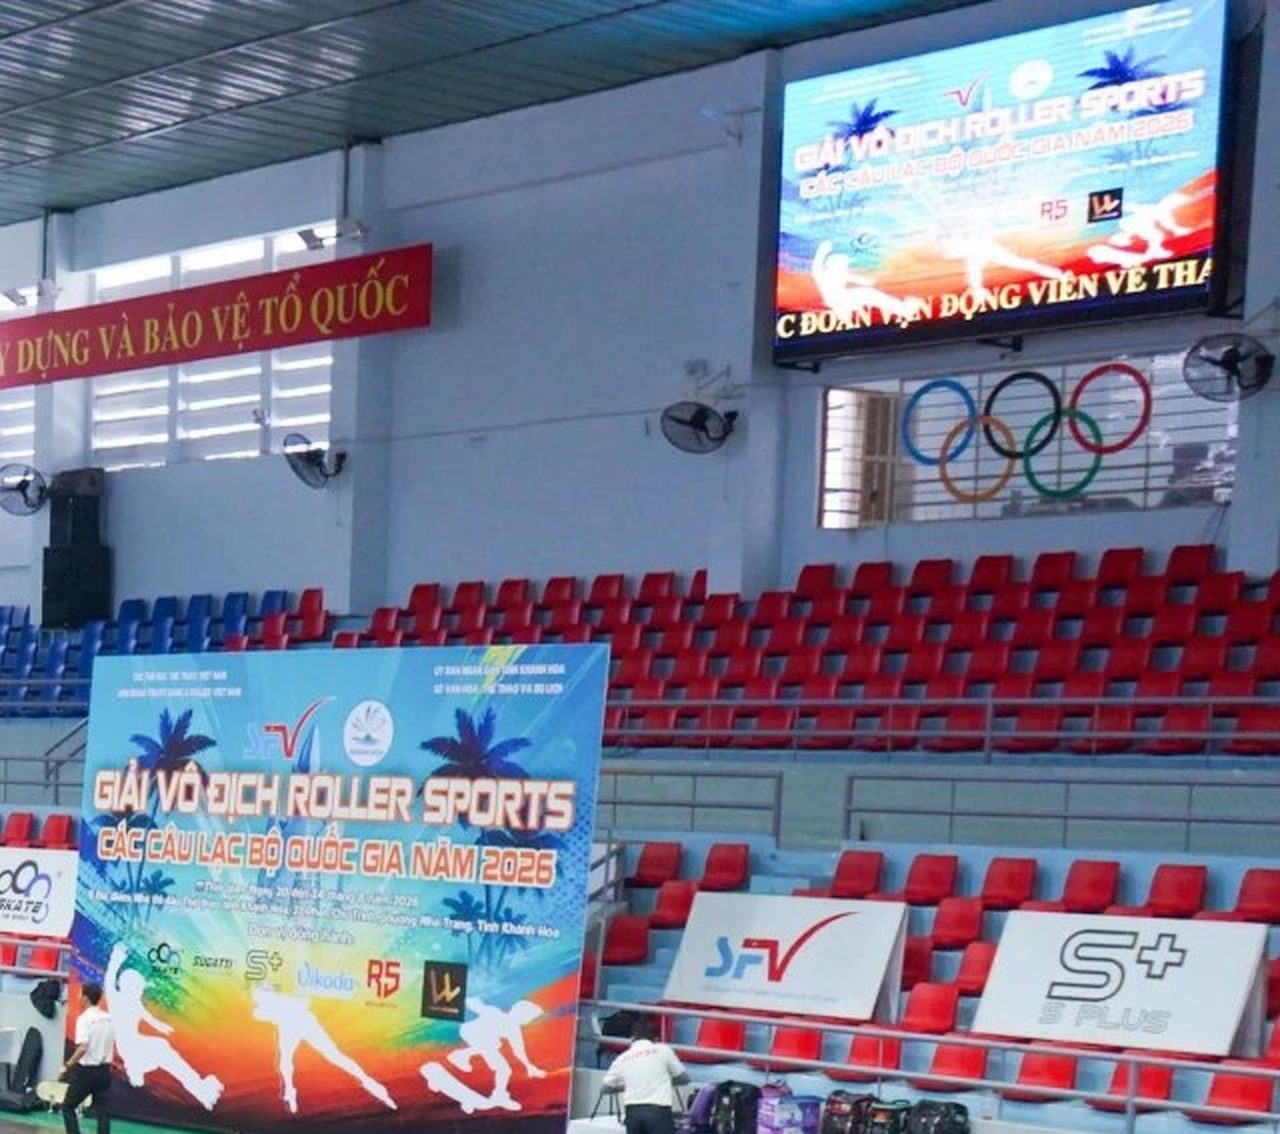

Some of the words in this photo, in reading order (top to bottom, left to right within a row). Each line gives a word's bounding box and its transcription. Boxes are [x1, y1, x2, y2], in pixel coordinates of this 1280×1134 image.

[966, 95, 1073, 142] ROLLER
[1081, 69, 1207, 118] SPORTS
[17, 328, 90, 380] DỰNG
[98, 311, 136, 361] VÀ
[143, 303, 203, 354] BẢO
[211, 290, 252, 350] VỆ
[258, 271, 303, 336] TỔ
[310, 257, 410, 335] QUỐC
[776, 314, 796, 339] C
[1028, 269, 1100, 306] VIÊN
[93, 757, 151, 813] GIẢI
[207, 771, 280, 824] ĐỊCH
[286, 773, 414, 824] ROLLER
[422, 776, 577, 832] SPORTS
[97, 819, 145, 862] CÁC
[147, 821, 193, 864] CÂU
[197, 828, 244, 880] LẠC
[247, 825, 282, 877] BỘ
[286, 820, 358, 874] QUỐC
[361, 839, 404, 878] GIA
[411, 837, 478, 882] NĂM
[480, 847, 557, 889] 2026
[1038, 1001, 1067, 1025] S
[1074, 1003, 1173, 1035] PLUS
